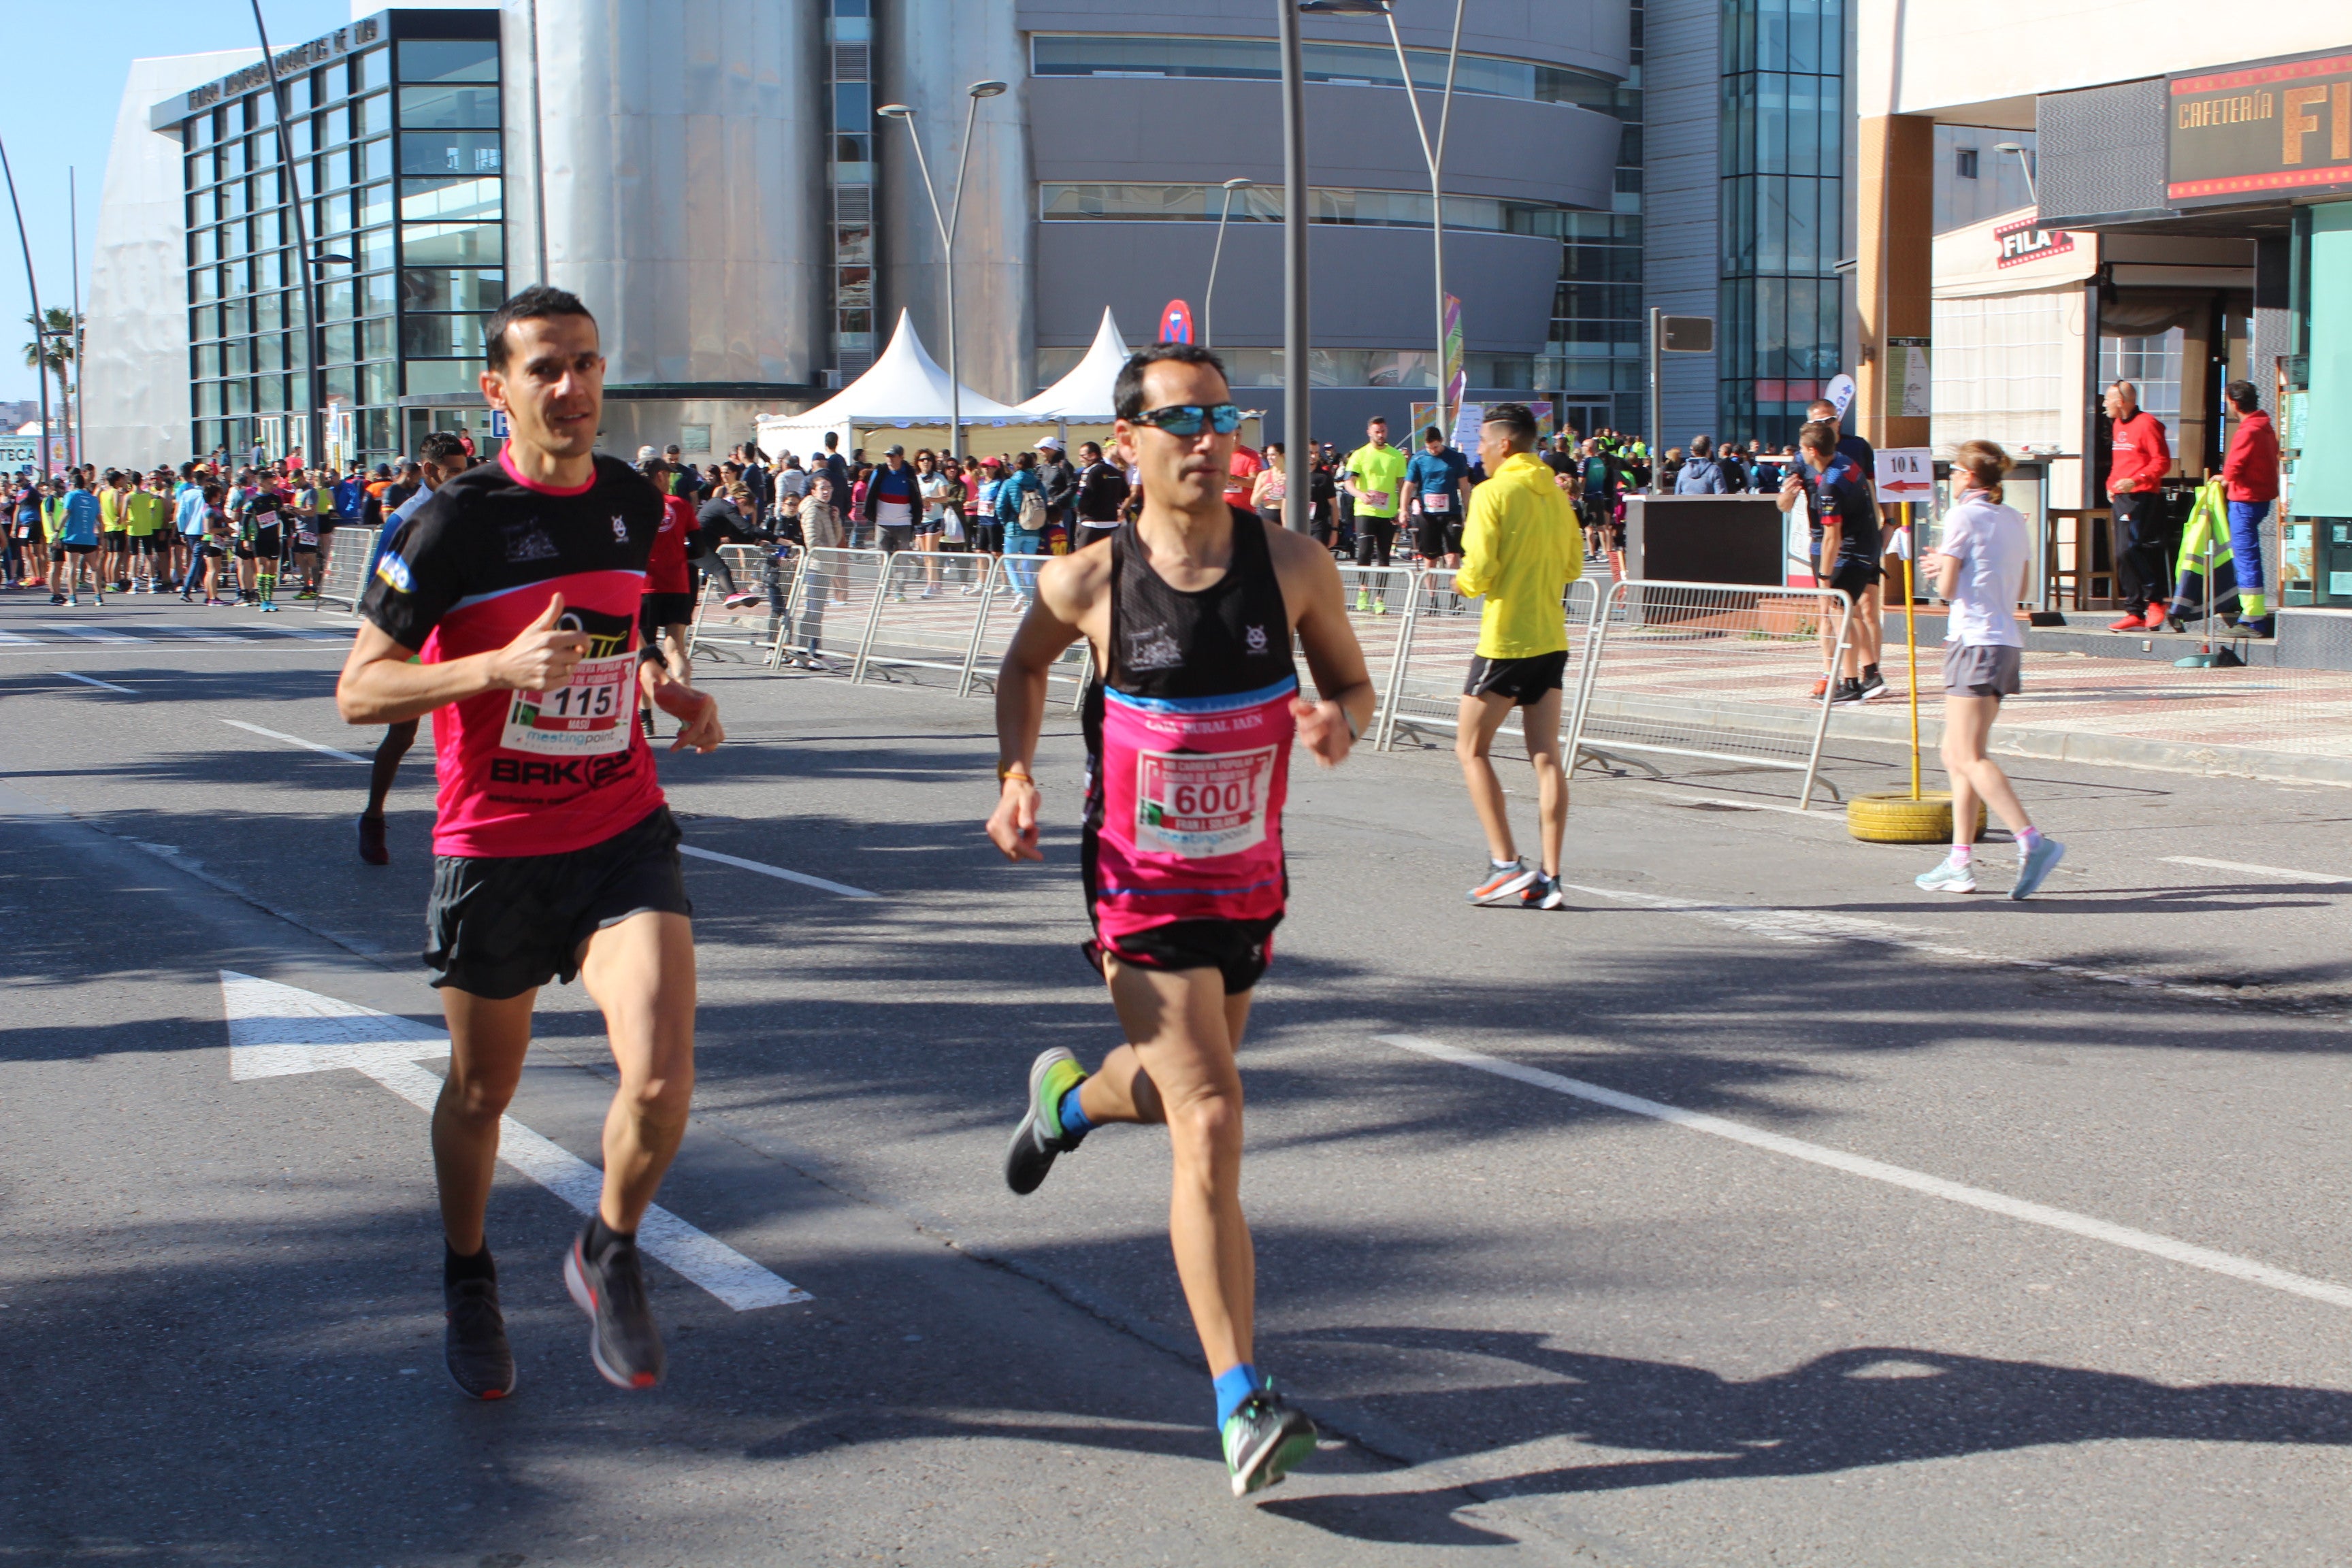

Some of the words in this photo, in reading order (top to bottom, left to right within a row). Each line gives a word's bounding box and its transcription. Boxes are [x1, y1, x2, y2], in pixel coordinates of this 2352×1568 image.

[2178, 89, 2273, 129] CAFETERÍA
[1891, 456, 1906, 473] 10
[1909, 456, 1919, 472] K
[555, 686, 612, 716] 115
[527, 730, 615, 745] meetingpoint
[1182, 720, 1230, 734] RURAL
[491, 758, 582, 785] BRK
[1174, 783, 1242, 815] 600
